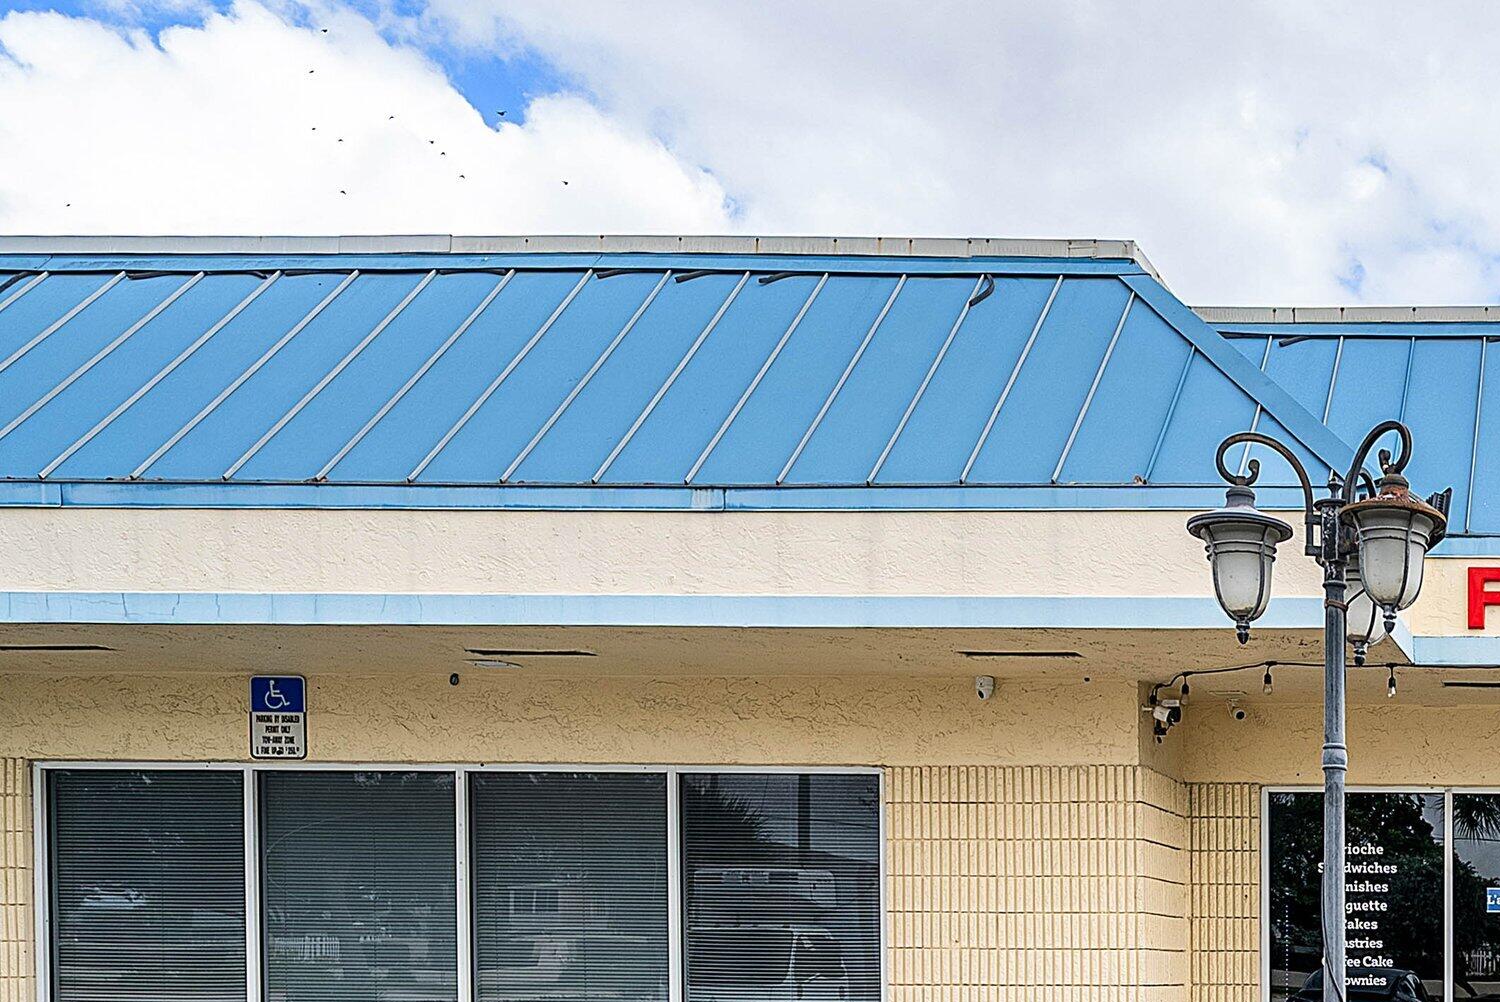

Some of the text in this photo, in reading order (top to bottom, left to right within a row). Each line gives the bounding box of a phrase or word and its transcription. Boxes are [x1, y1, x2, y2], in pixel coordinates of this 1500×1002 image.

[1344, 843, 1384, 855] rioche
[1317, 862, 1398, 874] Sdwiches
[1345, 881, 1389, 892] nishes
[1346, 900, 1388, 915] guette
[1344, 937, 1383, 948] stries
[1322, 956, 1394, 967] fee Cake
[1345, 975, 1387, 986] ownies
